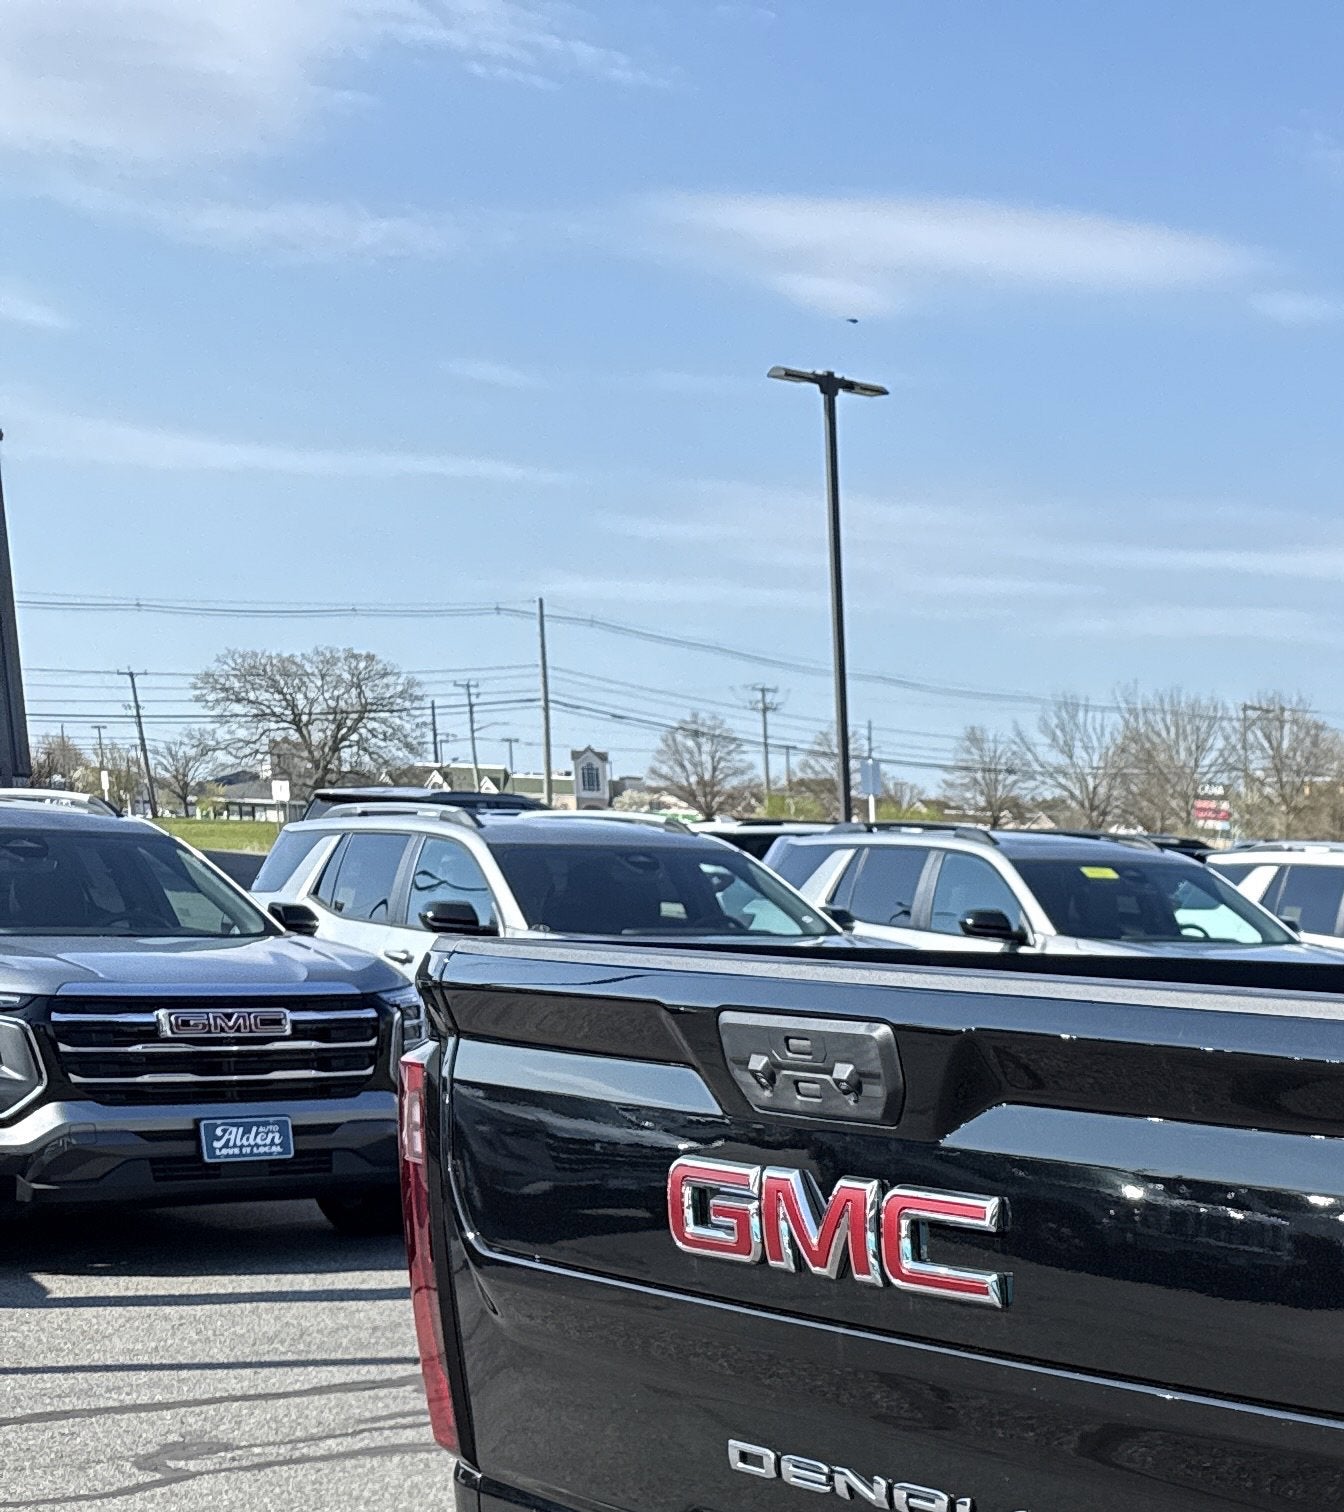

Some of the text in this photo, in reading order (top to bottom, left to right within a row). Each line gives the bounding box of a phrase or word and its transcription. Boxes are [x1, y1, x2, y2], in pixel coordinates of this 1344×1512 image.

[171, 1011, 286, 1034] GMC
[212, 1125, 284, 1148] Alden
[667, 1154, 1011, 1308] GMC
